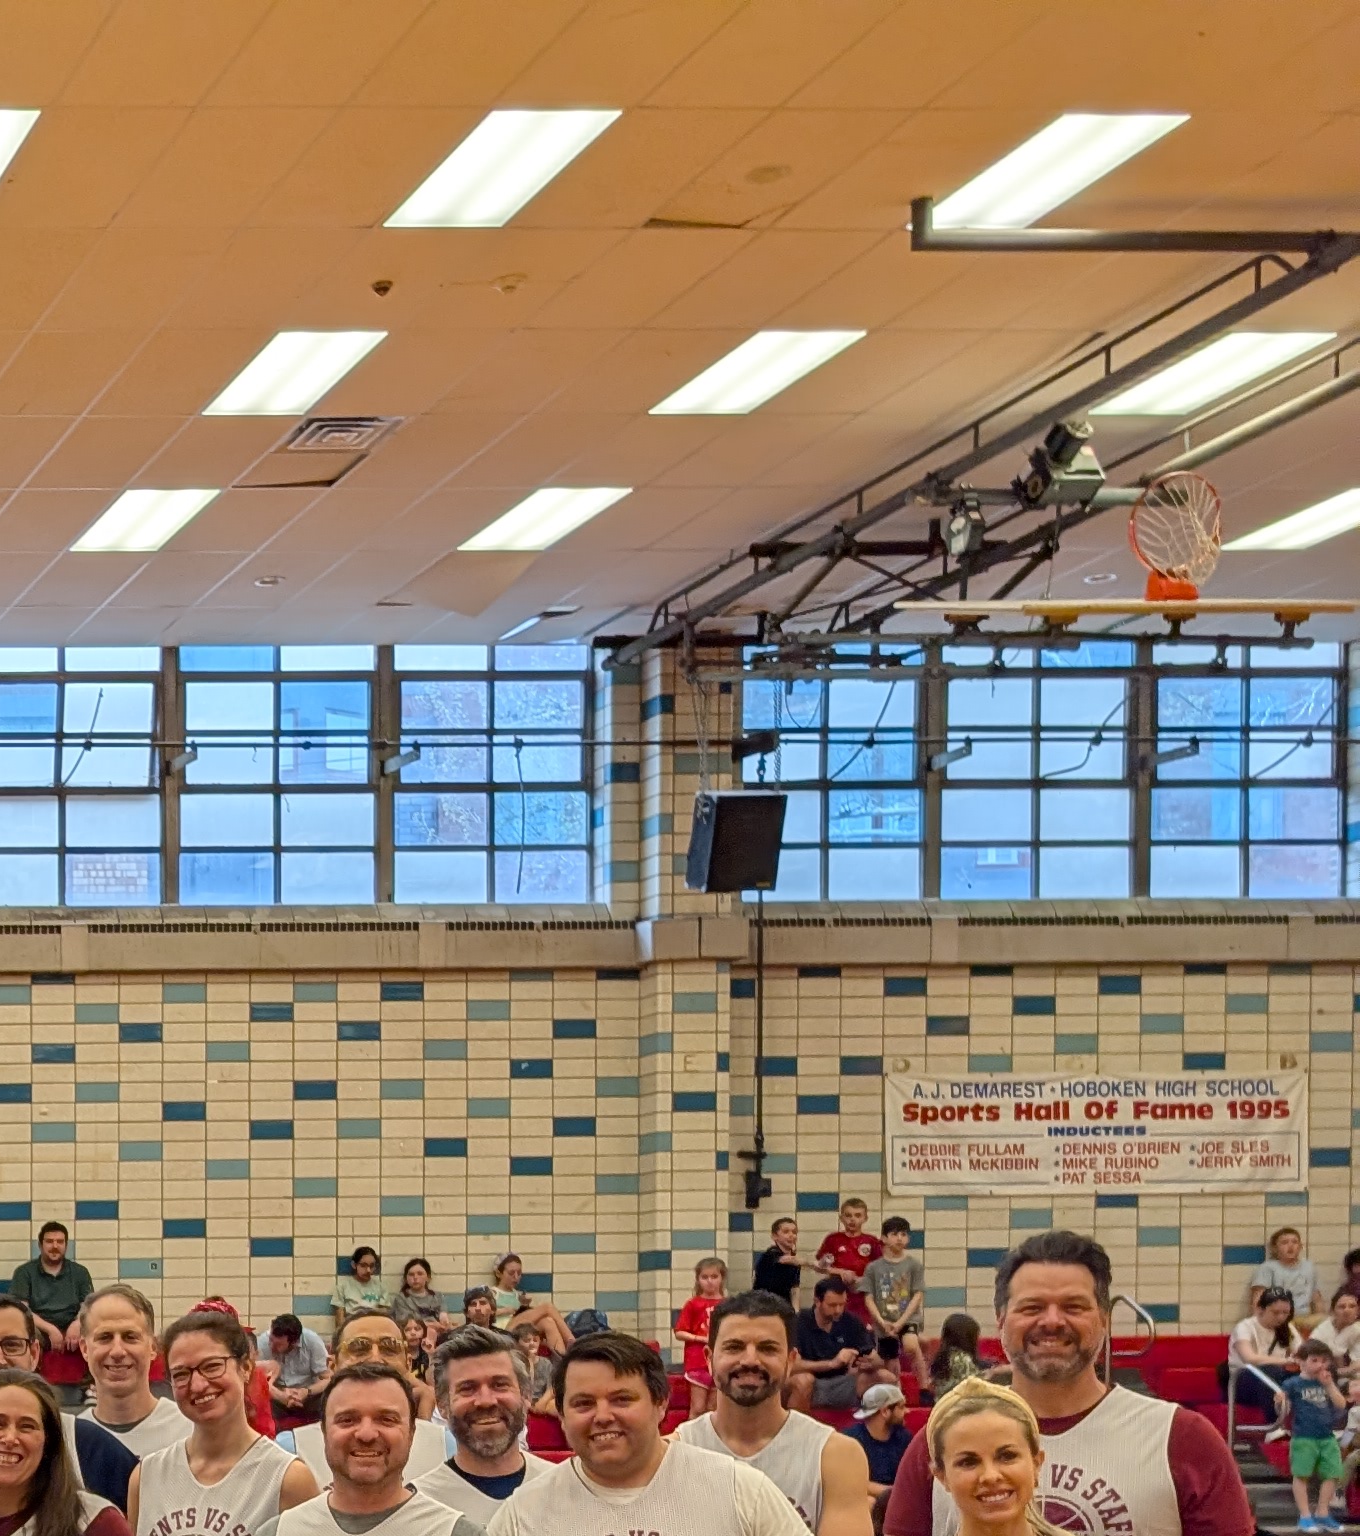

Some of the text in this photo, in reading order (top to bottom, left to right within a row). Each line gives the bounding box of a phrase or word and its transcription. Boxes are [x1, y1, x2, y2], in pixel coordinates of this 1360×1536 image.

[950, 1082, 1046, 1099] DEMAREST
[1060, 1081, 1146, 1098] HOBOKEN
[1155, 1081, 1197, 1097] HIGH
[1205, 1080, 1280, 1097] SCHOOL
[902, 1100, 1290, 1125] Sports Hall Of Fame 1995
[1047, 1126, 1146, 1136] INDUCTEES
[908, 1143, 1025, 1156] DEBBIE FULLAM
[1062, 1142, 1181, 1155] DENNIS O'BRIEN
[1196, 1141, 1225, 1154] JOE
[908, 1158, 1039, 1171] MARTIN McKIBBIN
[1062, 1157, 1159, 1169] MIKE RUBINO
[1196, 1154, 1291, 1168] JERRY SMITH
[1062, 1171, 1141, 1184] PAT SESSA
[1051, 1463, 1083, 1492] VS
[204, 1507, 231, 1533] VS
